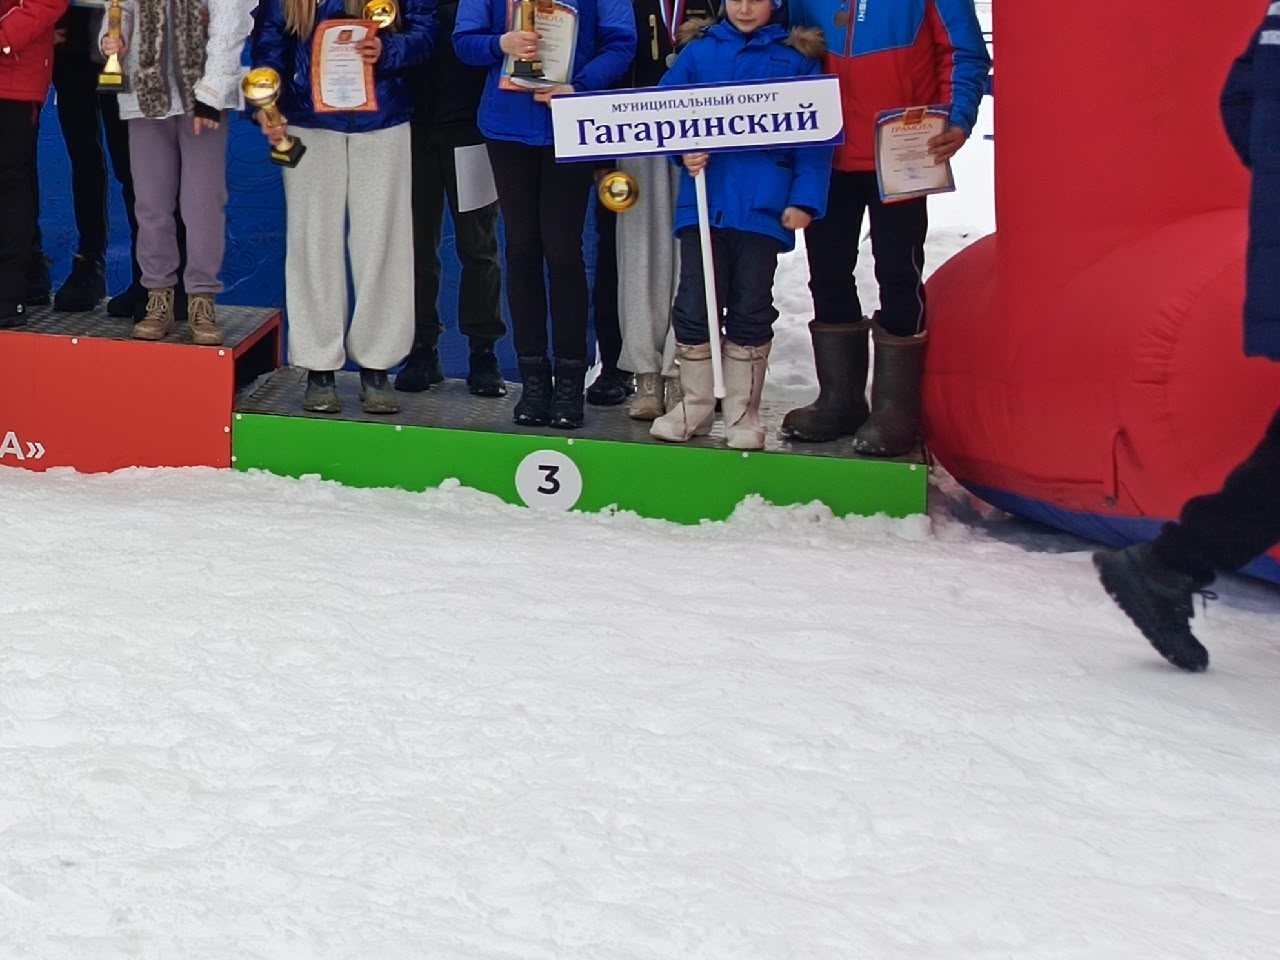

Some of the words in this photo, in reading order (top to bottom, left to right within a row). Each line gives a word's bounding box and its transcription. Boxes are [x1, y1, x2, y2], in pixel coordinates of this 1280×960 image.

[612, 93, 735, 113] МУНИЦИПАЛЬНЫЙ
[738, 91, 779, 105] ОКРУГ
[576, 102, 819, 148] Гагаринский
[537, 464, 561, 495] 3
